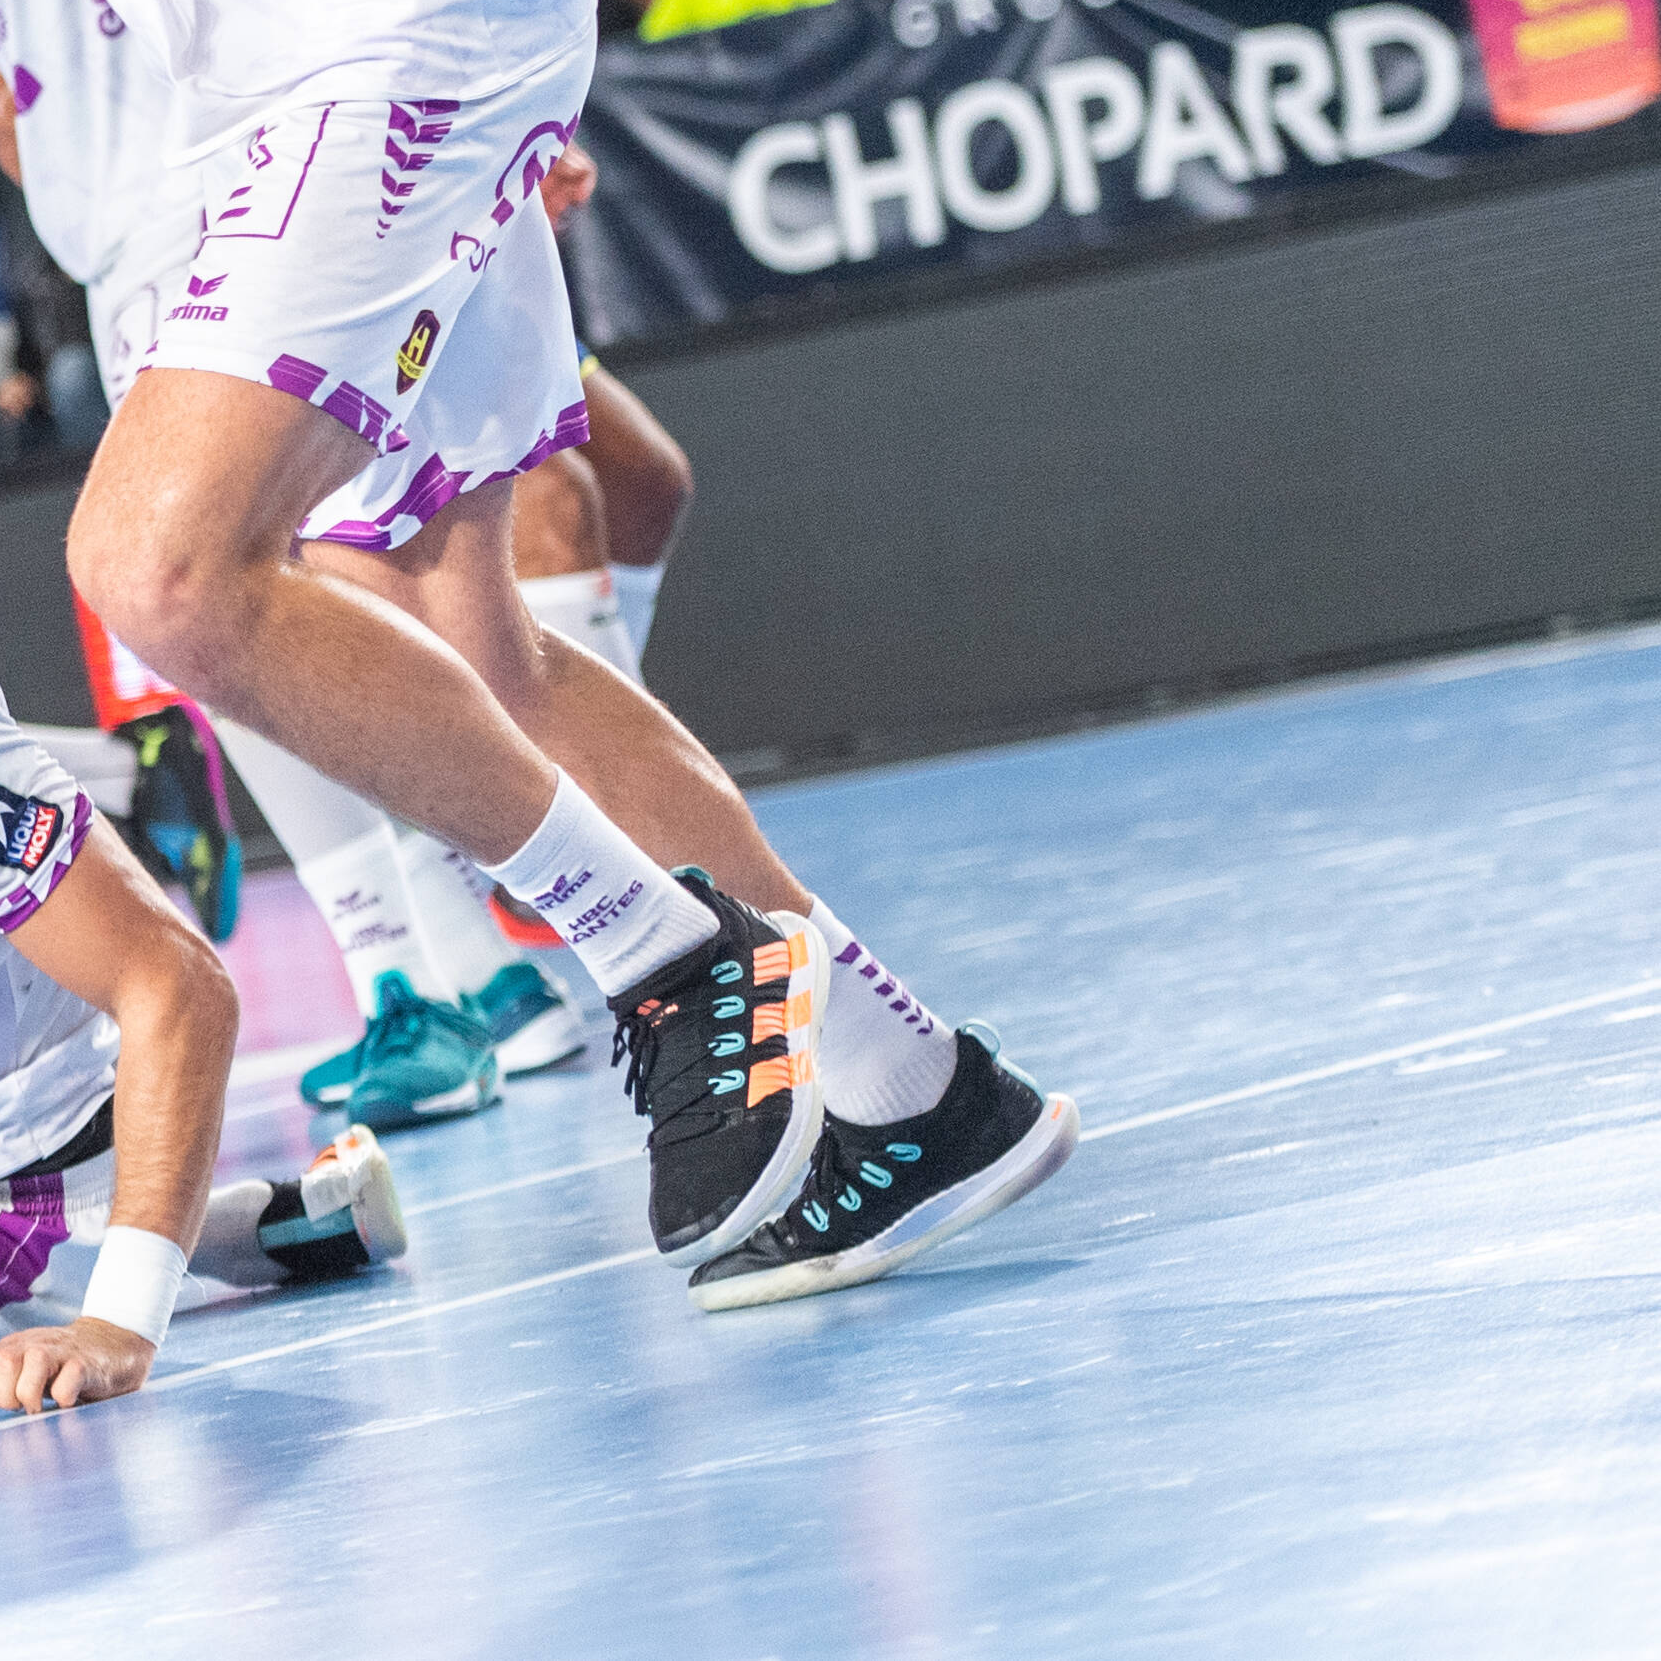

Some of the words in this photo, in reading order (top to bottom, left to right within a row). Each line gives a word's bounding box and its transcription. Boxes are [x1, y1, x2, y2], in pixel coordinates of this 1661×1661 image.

[728, 3, 1465, 277] CHOPARD
[24, 806, 55, 867] MOLY
[568, 894, 615, 931] HBC
